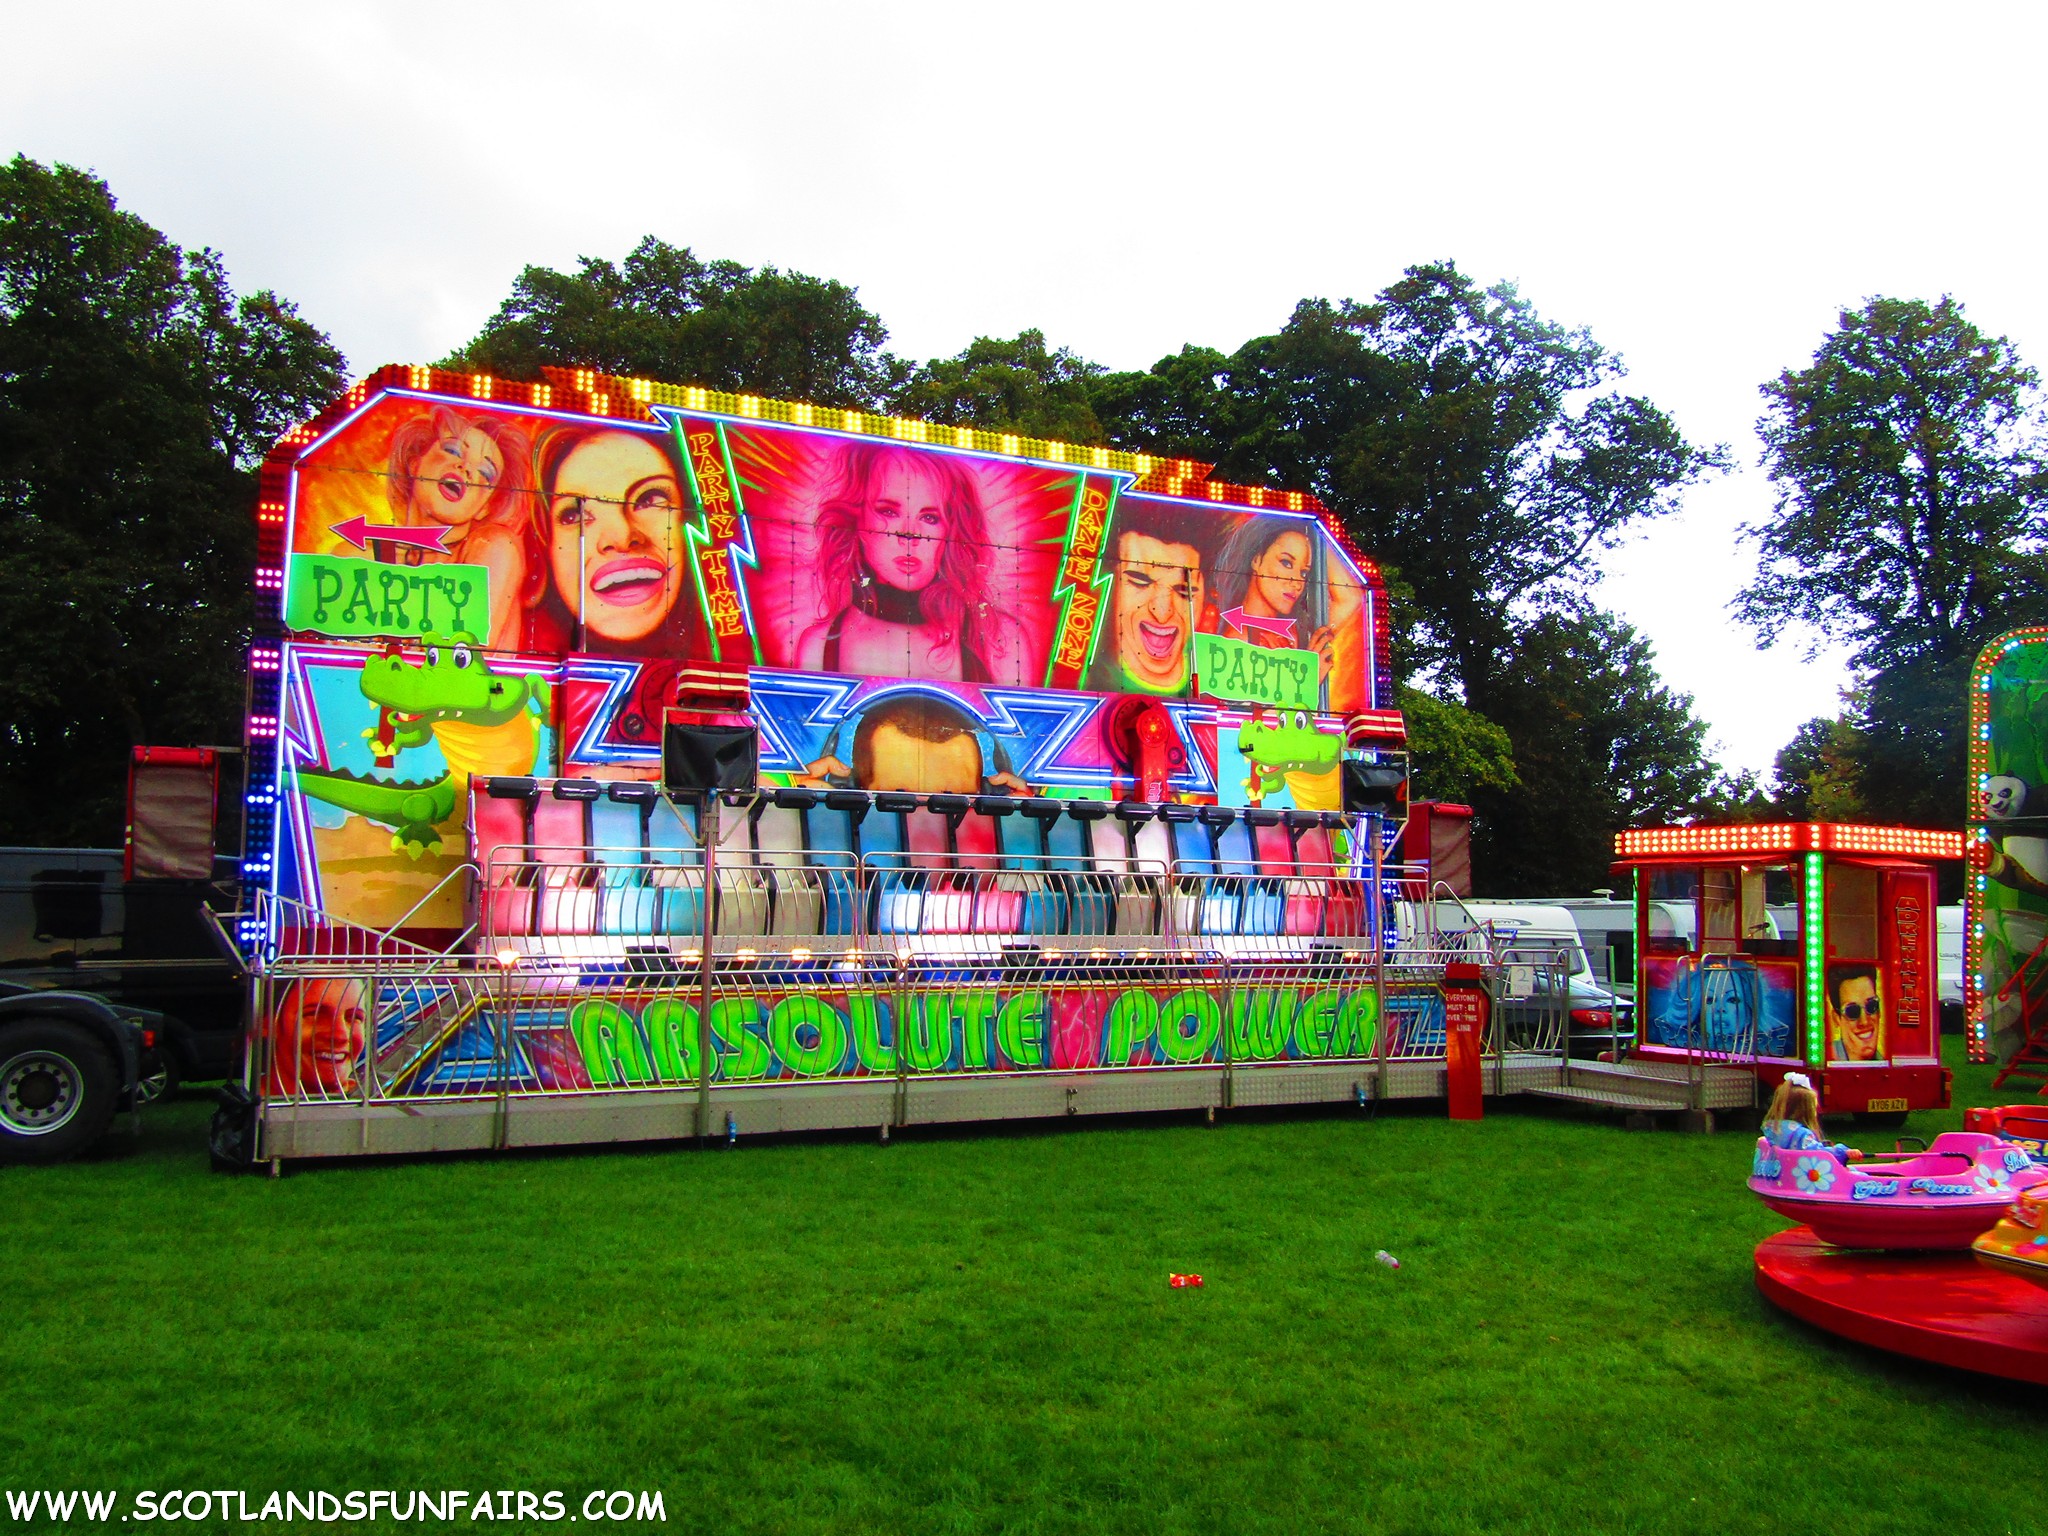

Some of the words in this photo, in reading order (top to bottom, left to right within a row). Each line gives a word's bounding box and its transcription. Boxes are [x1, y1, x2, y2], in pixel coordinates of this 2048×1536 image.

[690, 433, 736, 538] PARTY
[1065, 487, 1109, 583] DANCE
[313, 565, 472, 632] PARTY
[702, 549, 743, 636] TIME
[1057, 592, 1097, 670] ZONE
[1209, 642, 1308, 702] PARTY
[1895, 896, 1921, 1025] ADRENALINE
[570, 994, 1045, 1083] ABSOLUTE
[1107, 986, 1378, 1064] POWER
[1853, 1180, 1899, 1200] Girl
[1908, 1178, 1976, 1196] Power
